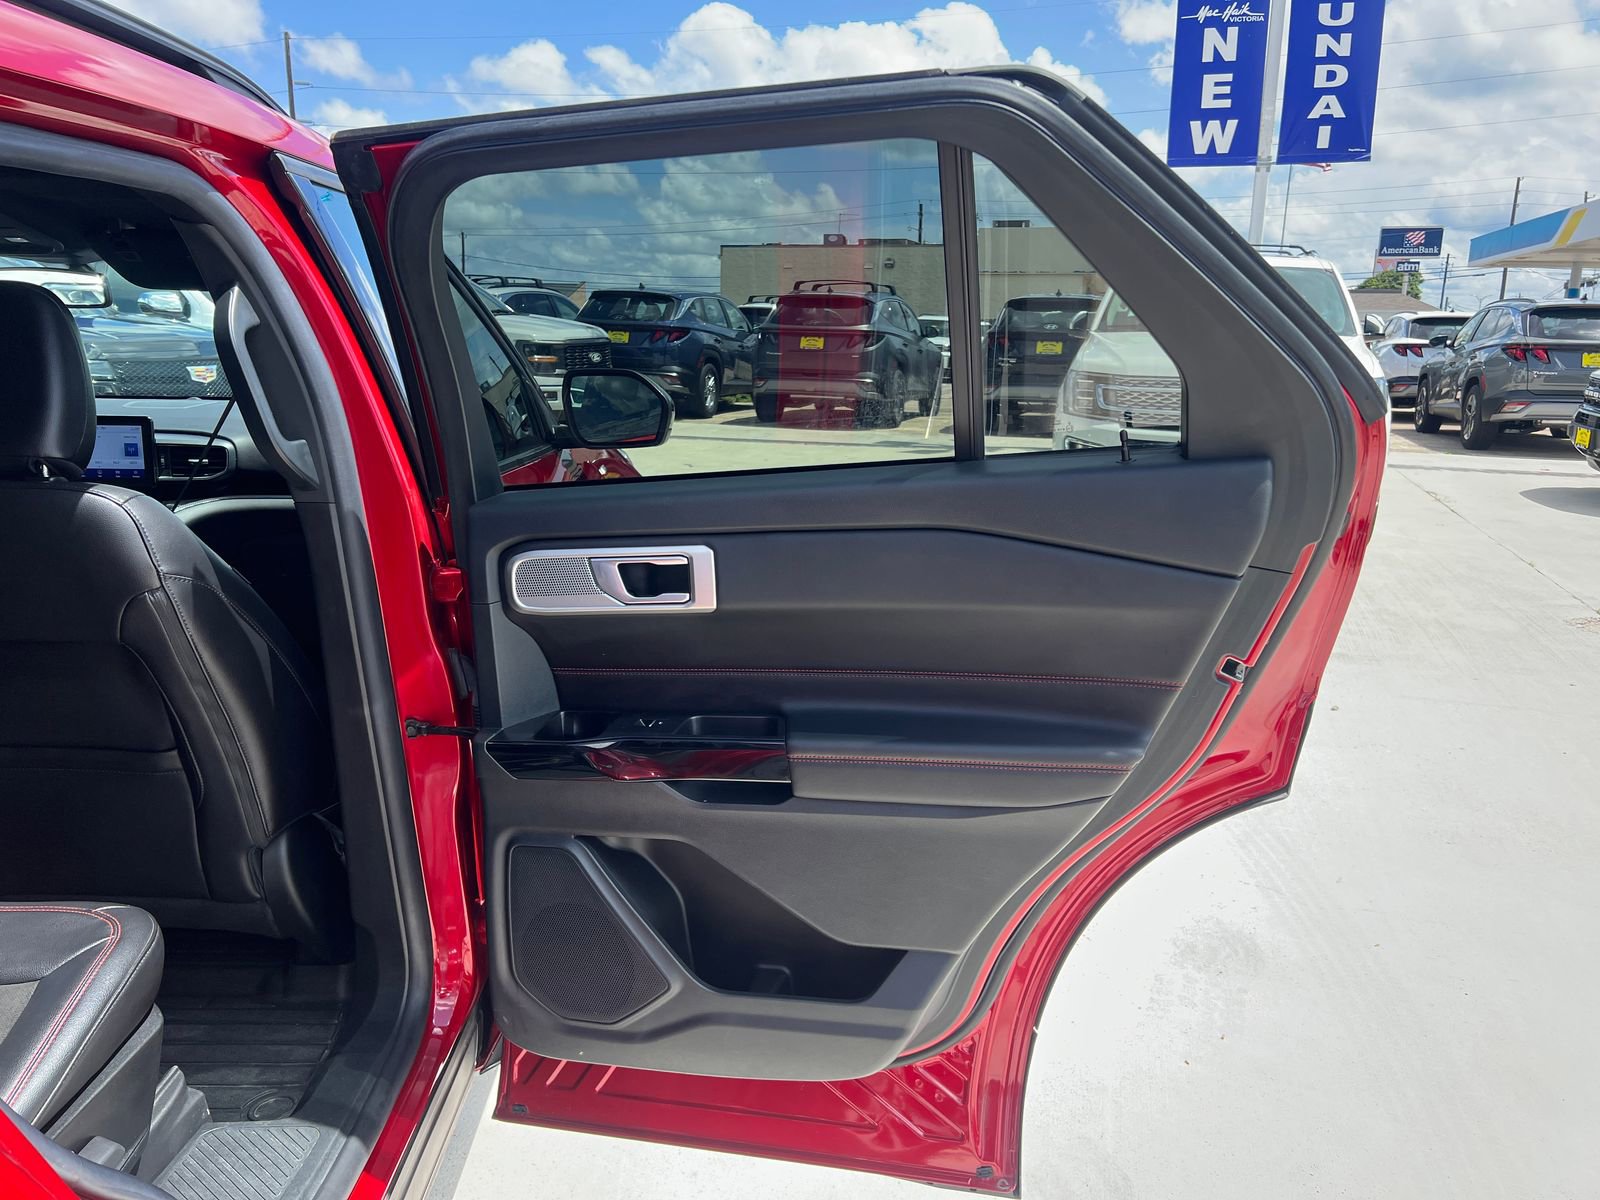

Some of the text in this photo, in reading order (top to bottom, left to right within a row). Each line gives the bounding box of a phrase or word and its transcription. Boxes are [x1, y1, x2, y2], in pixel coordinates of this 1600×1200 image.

[1181, 2, 1264, 24] Mac Haik
[1189, 26, 1239, 155] NEW
[1381, 246, 1439, 254] AmericanBank
[1397, 263, 1419, 271] atm
